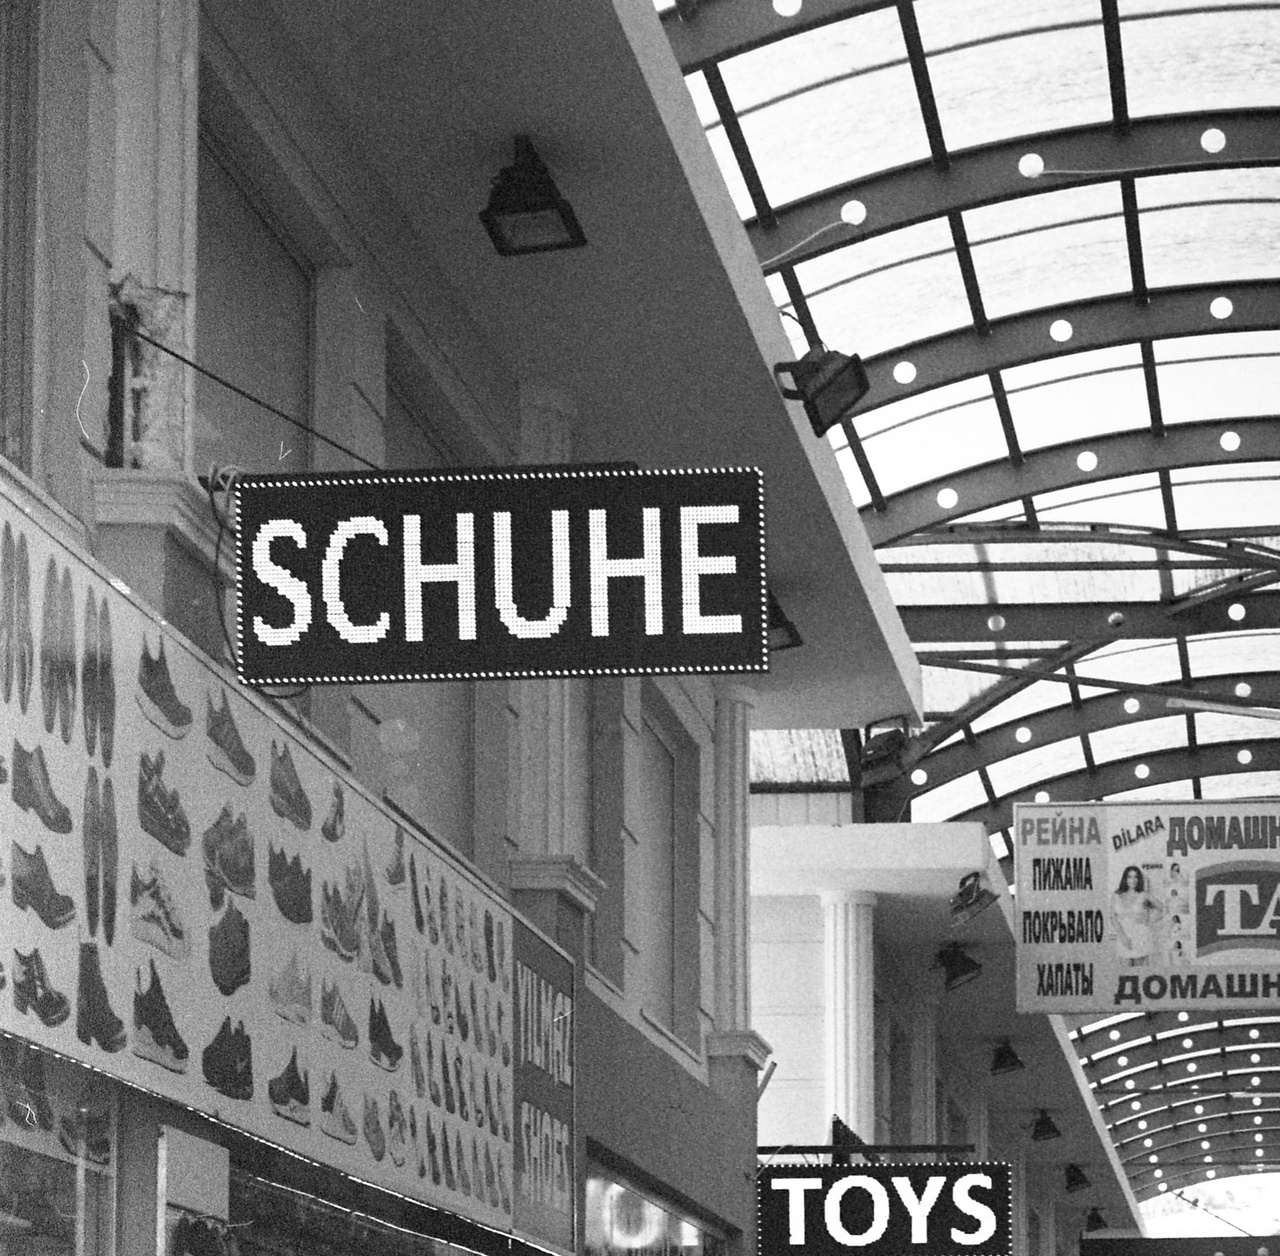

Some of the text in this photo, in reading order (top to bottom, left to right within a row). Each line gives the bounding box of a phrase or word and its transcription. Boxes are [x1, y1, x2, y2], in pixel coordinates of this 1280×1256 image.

[252, 505, 742, 646] SCHUHE
[1021, 811, 1101, 846] РЕЙНА
[1112, 816, 1165, 851] DİLARA
[1032, 857, 1093, 891] ПИЖАМА
[517, 960, 572, 1087] YILMAZ
[521, 1101, 570, 1212] SHOES
[771, 1173, 996, 1247] TOYS
